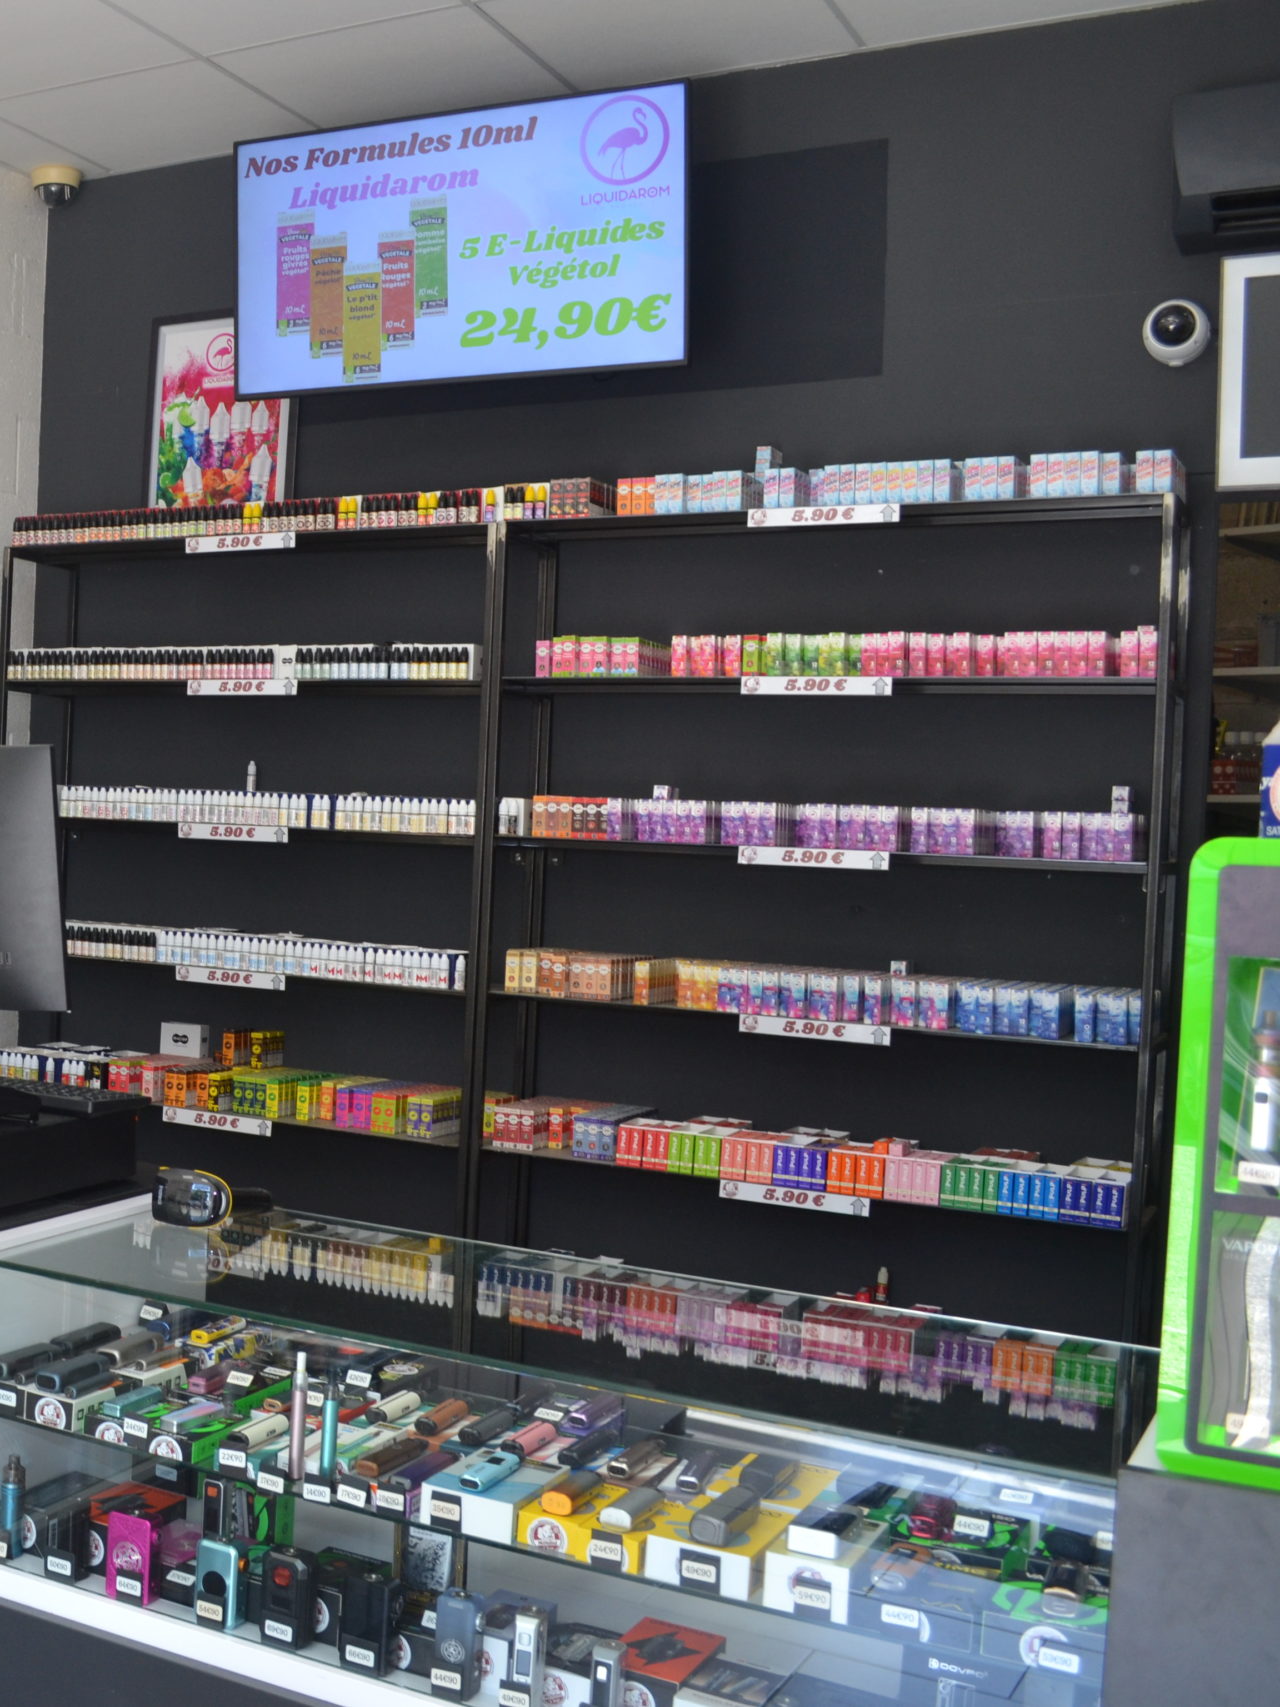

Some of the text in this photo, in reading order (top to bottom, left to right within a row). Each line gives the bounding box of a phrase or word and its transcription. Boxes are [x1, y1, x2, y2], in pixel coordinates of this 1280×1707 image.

[245, 116, 538, 178] Nos Formules 10ml
[289, 168, 479, 210] Liquidarom
[580, 185, 671, 206] LIQUIDAROM
[459, 237, 481, 259] 5
[486, 218, 665, 257] E-Liquides
[460, 294, 671, 350] 24,90€
[791, 508, 855, 521] 5.90 €
[216, 536, 263, 548] 5.90 €
[219, 681, 265, 692] 5.90 €
[784, 680, 847, 691] 5.90 €
[210, 826, 256, 837] 5.90 €
[781, 850, 844, 864] 5.90 €
[207, 971, 253, 984] 5.90 €
[783, 1021, 845, 1037] 5.90 €
[194, 1114, 239, 1128] 5.90 €
[763, 1189, 825, 1206] 5.90 €
